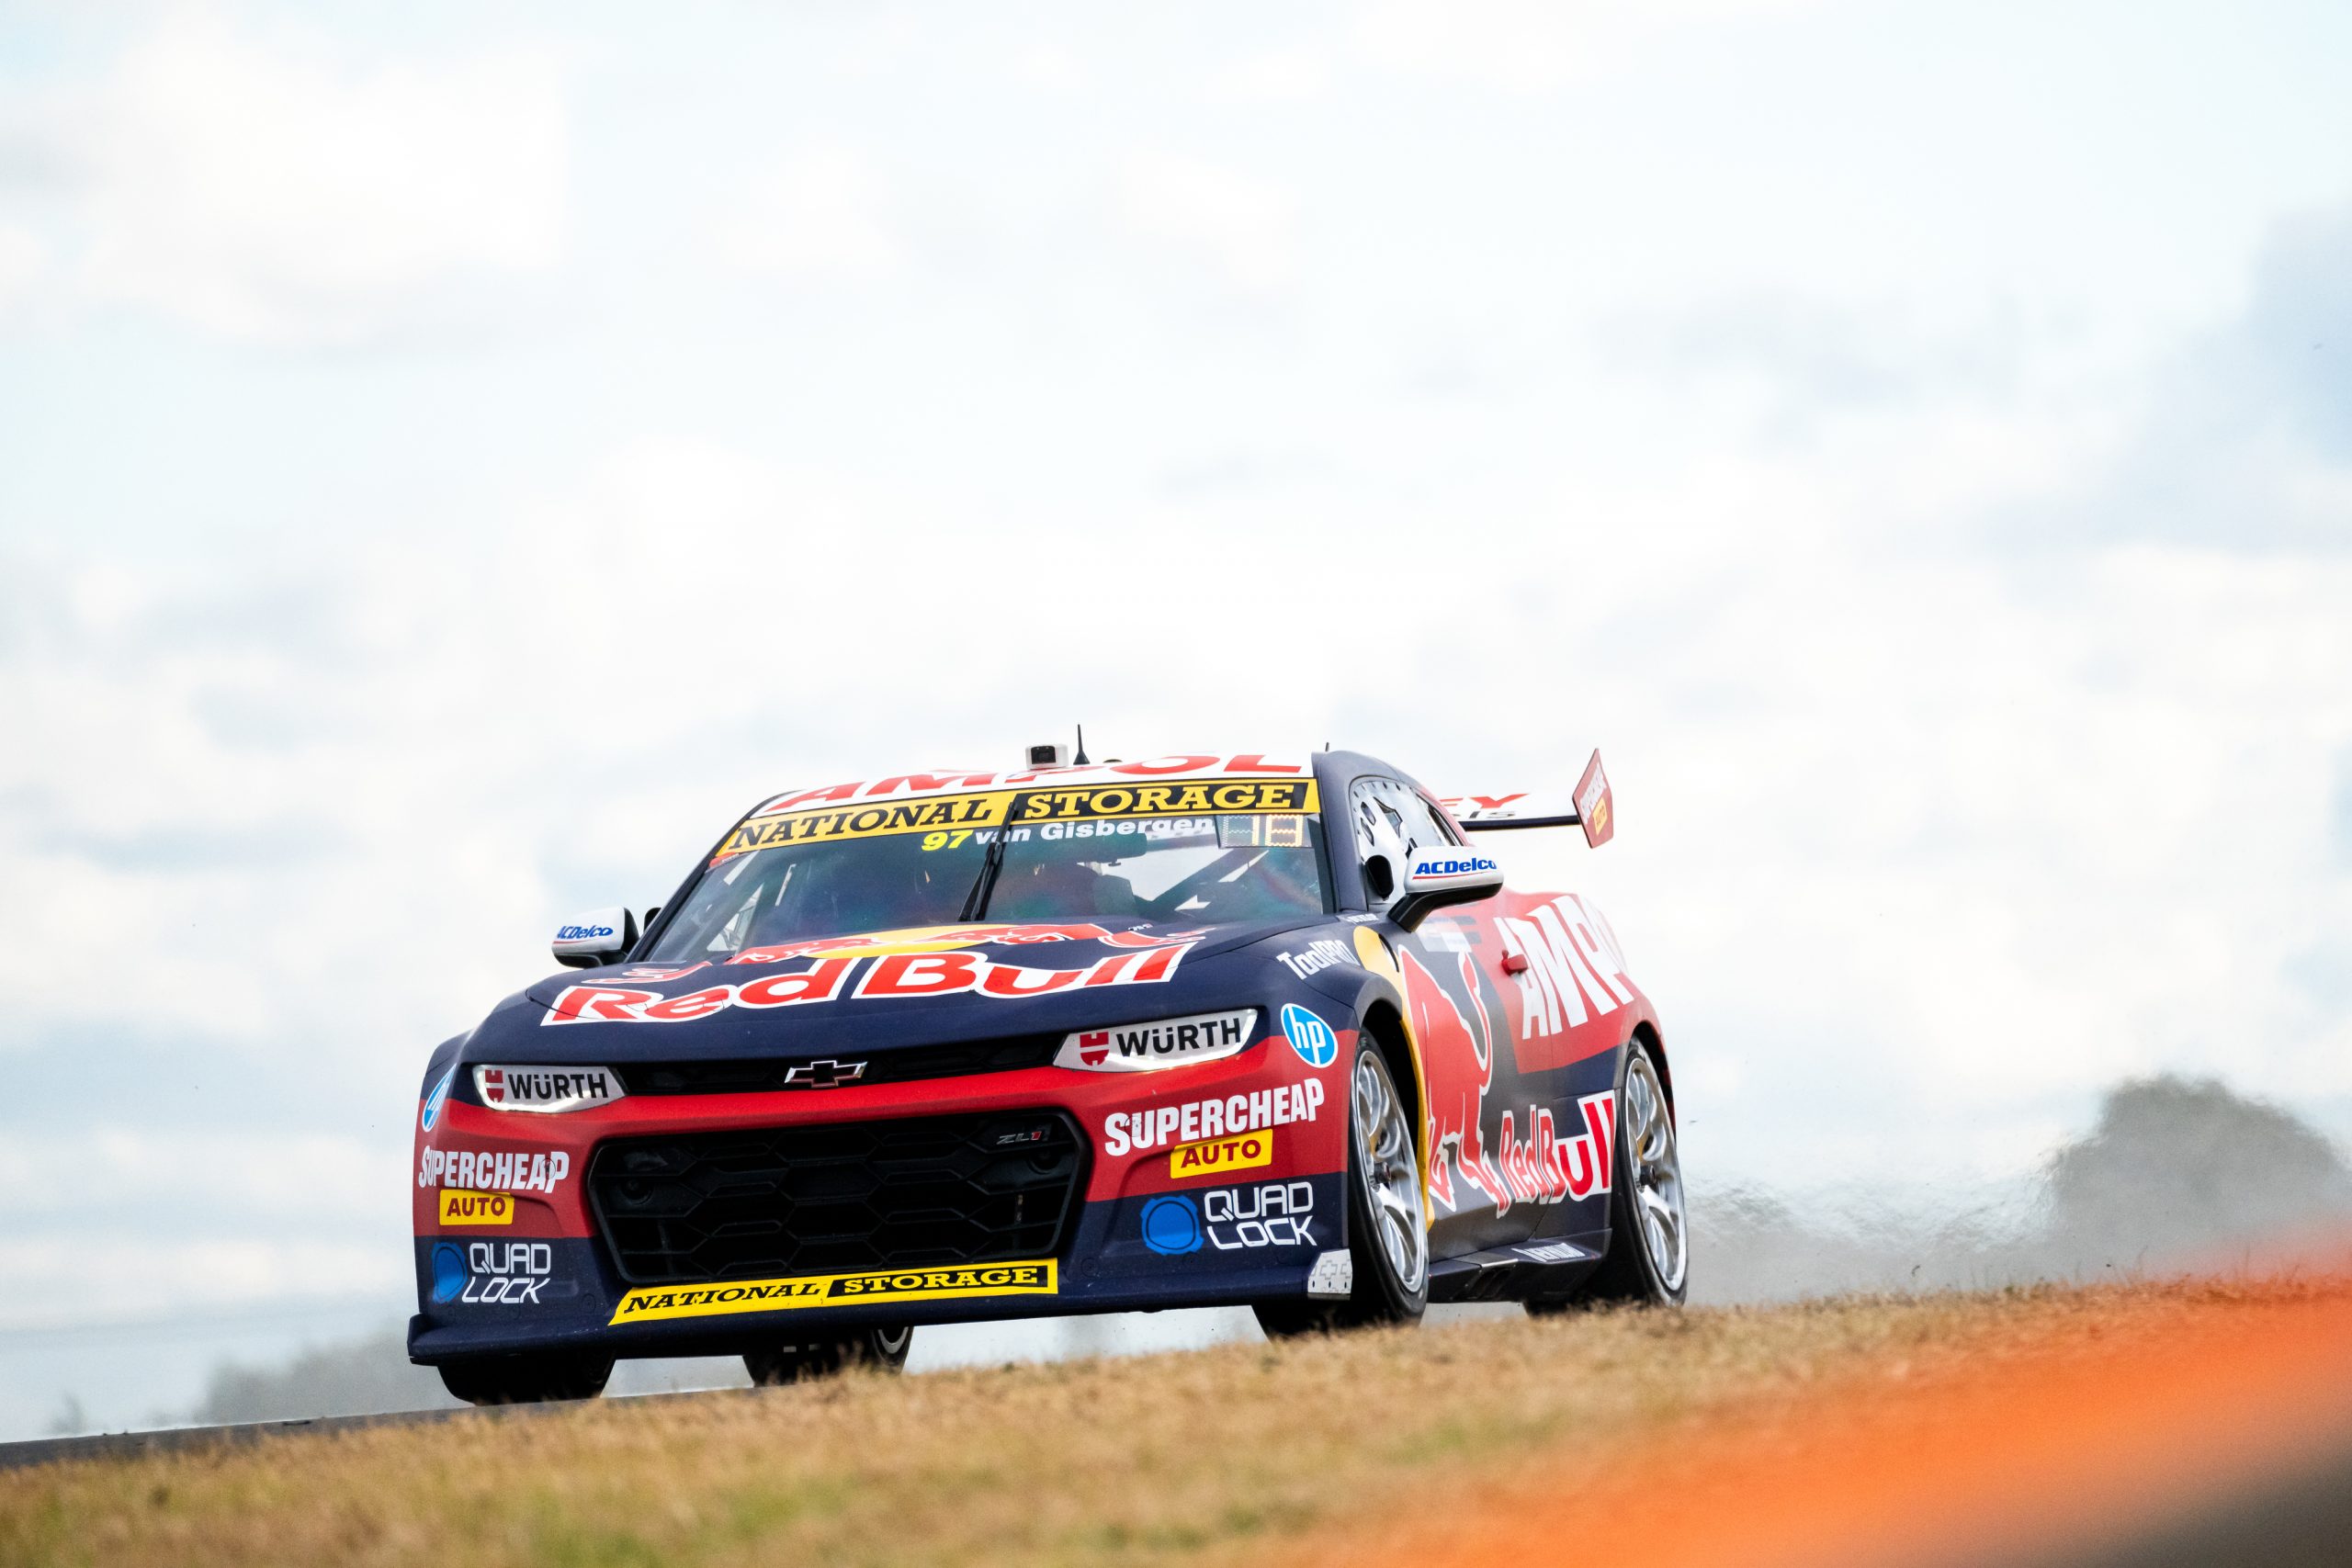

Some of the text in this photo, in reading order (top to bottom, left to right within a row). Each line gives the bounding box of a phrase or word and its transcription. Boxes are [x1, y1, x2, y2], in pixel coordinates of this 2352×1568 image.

[728, 784, 1295, 850] NATIONAL STORAGE
[921, 829, 974, 852] 97
[1040, 818, 1216, 840] Gisbergen
[1414, 857, 1498, 874] ACDelco
[1116, 1017, 1241, 1057] WÜRTH
[1289, 1004, 1329, 1066] hp
[507, 1073, 609, 1100] WÜRTH
[1104, 1077, 1325, 1156] SUPERCHEAP
[418, 1145, 570, 1194] SUPERCHEAP
[1180, 1139, 1262, 1169] AUTO
[447, 1197, 506, 1217] AUTO
[1204, 1181, 1314, 1222] QUAD
[1206, 1215, 1318, 1250] LOCK
[469, 1243, 551, 1275] QUAD
[461, 1277, 551, 1304] LOCK
[623, 1267, 1038, 1314] NATIONAL STORAGE
